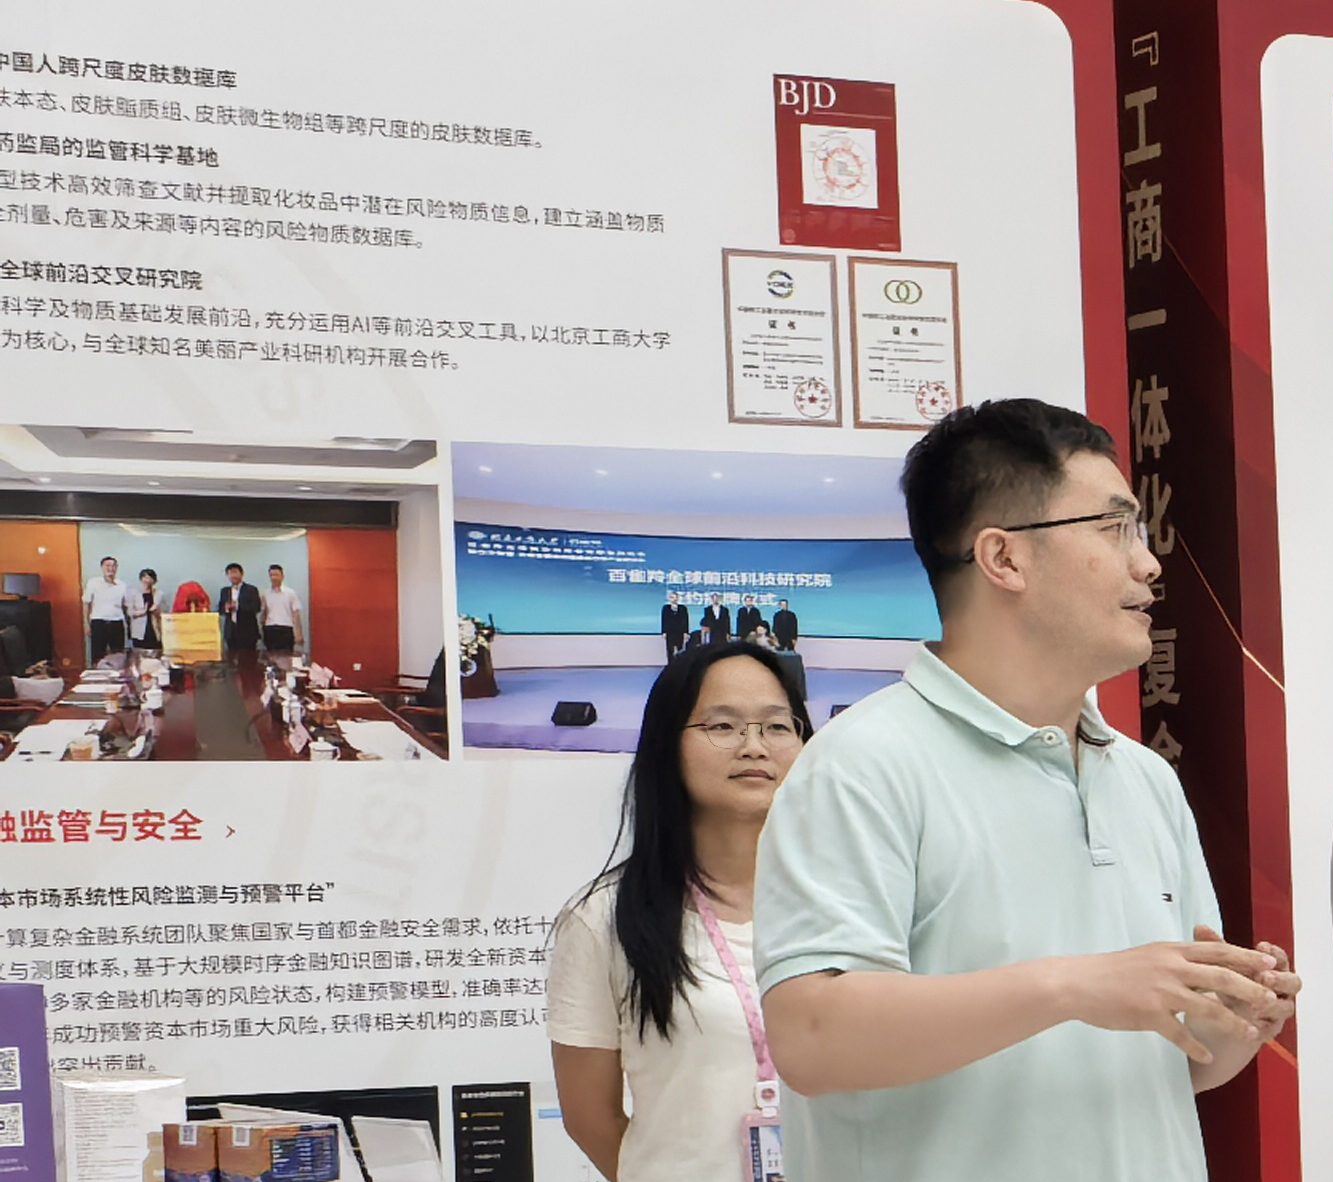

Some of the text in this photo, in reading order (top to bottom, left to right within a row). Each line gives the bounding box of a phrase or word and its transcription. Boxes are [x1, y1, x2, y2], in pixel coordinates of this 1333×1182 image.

[779, 78, 836, 115] BJD
[0, 259, 203, 290] 全球前沿交叉研究院
[0, 915, 552, 947] 算复杂金融系统团队聚焦国家与首都金融安全需求，依托十
[45, 978, 548, 1012] 多家金融机构等的风险状态，构建预警模型，准确率达
[47, 1008, 549, 1044] 成功预警资本市场重大风险，获得相关机构的高度认
[51, 1054, 156, 1073] 突出贡献。
